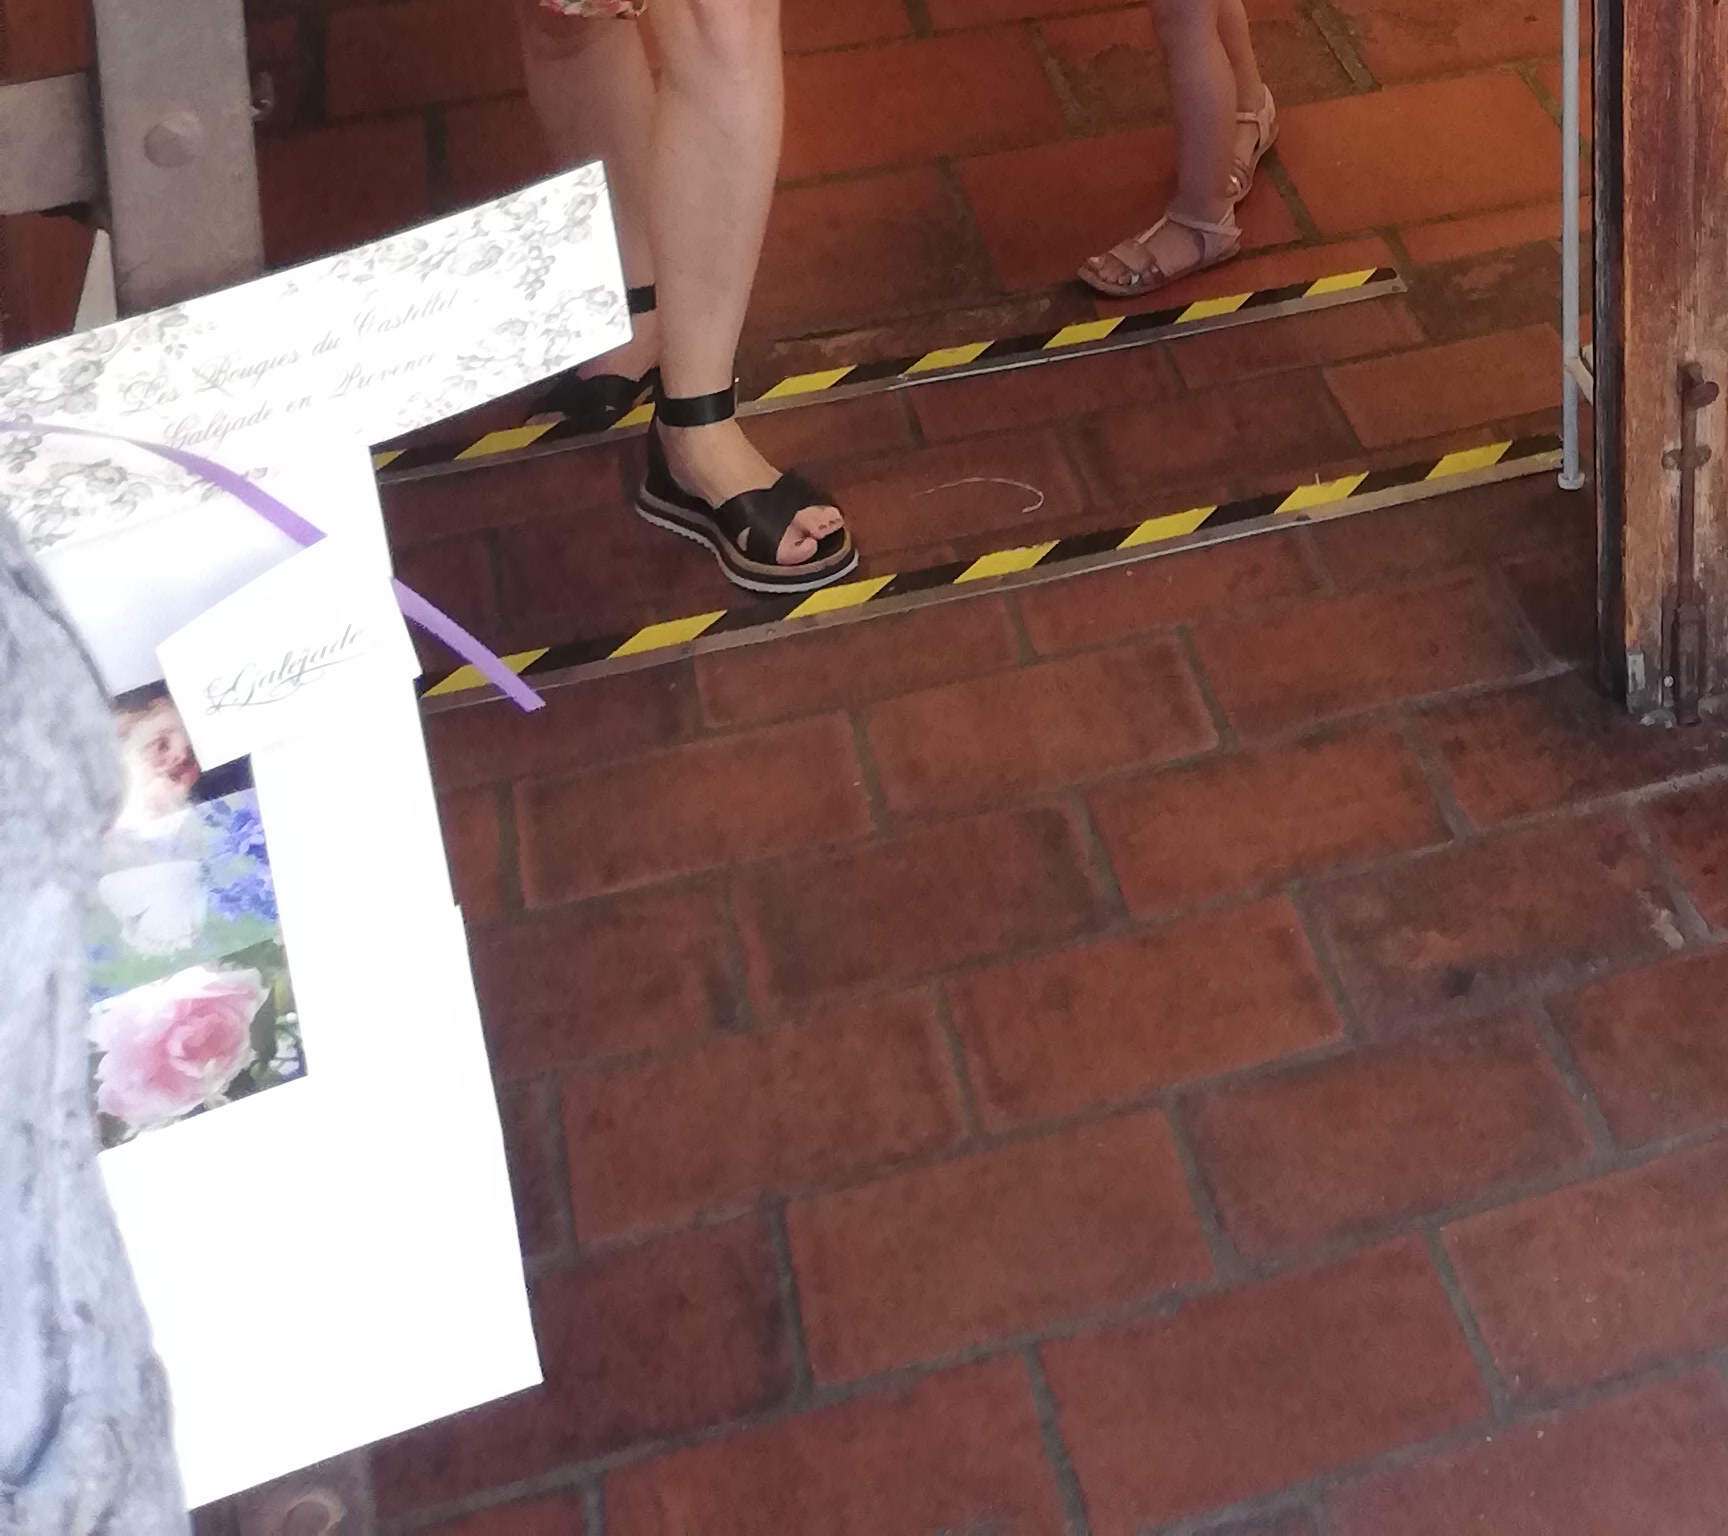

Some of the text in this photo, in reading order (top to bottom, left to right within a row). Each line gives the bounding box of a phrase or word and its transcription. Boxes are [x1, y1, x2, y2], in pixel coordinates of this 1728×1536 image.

[192, 349, 300, 398] Bougies
[312, 330, 342, 356] du
[285, 392, 313, 414] en
